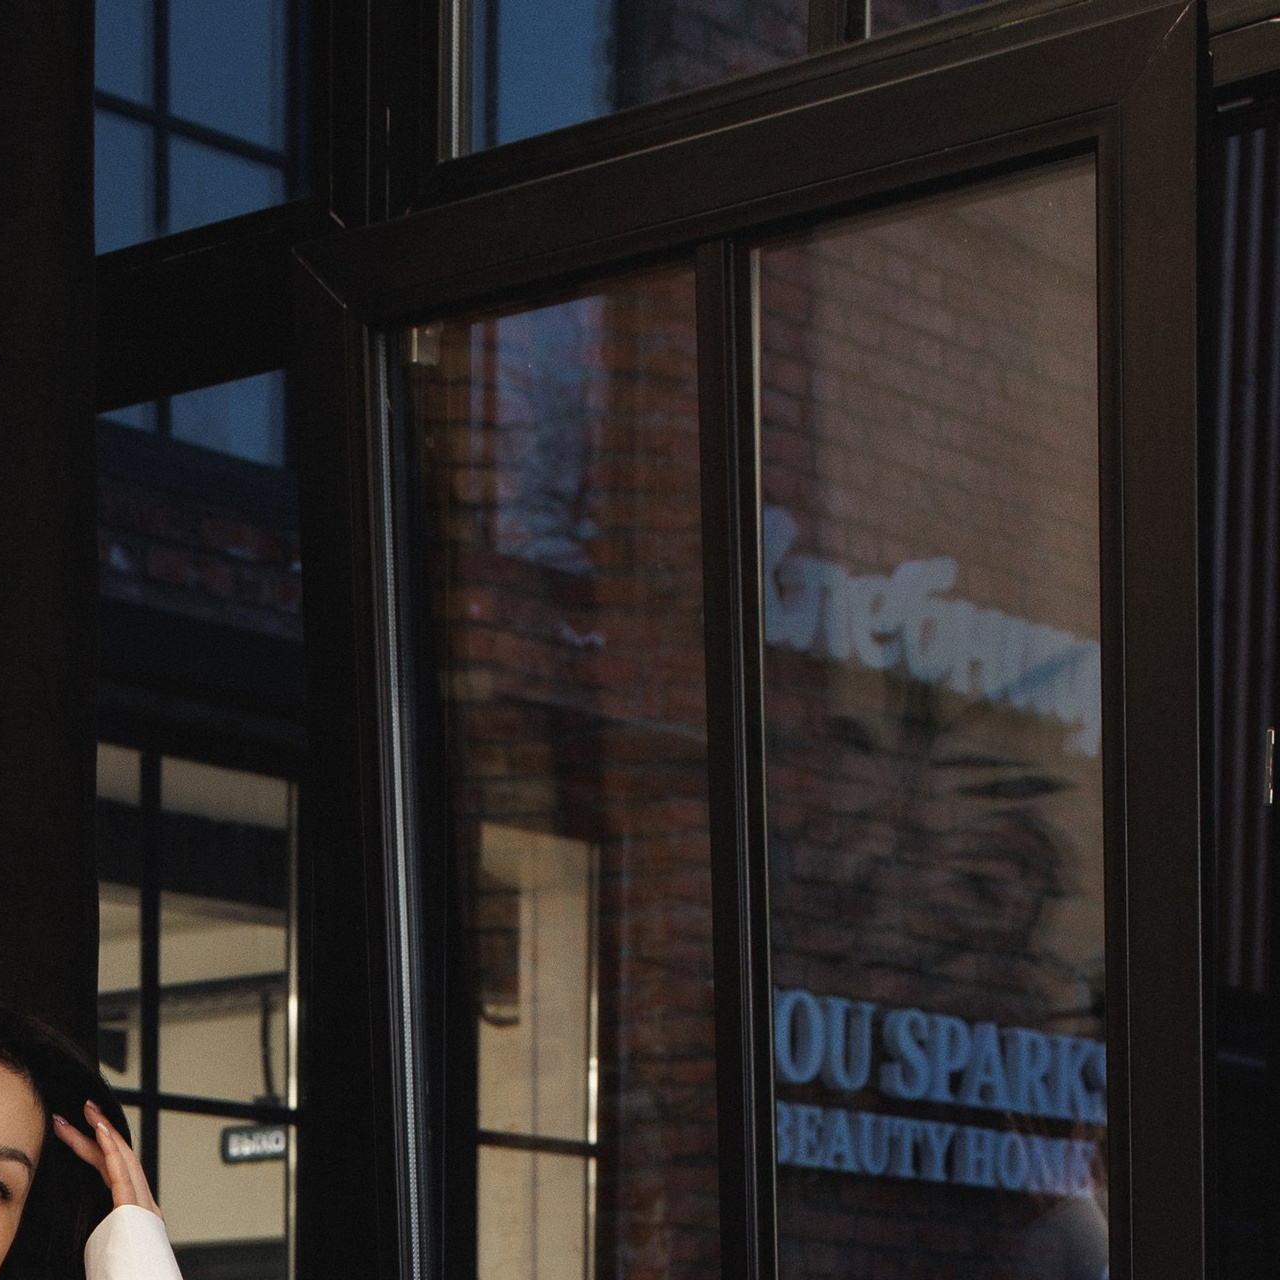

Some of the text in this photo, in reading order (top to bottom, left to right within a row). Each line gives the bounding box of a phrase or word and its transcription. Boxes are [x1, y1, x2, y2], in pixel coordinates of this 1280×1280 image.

[773, 986, 1107, 1127] OU SPARK
[228, 1129, 286, 1157] ВЫХО
